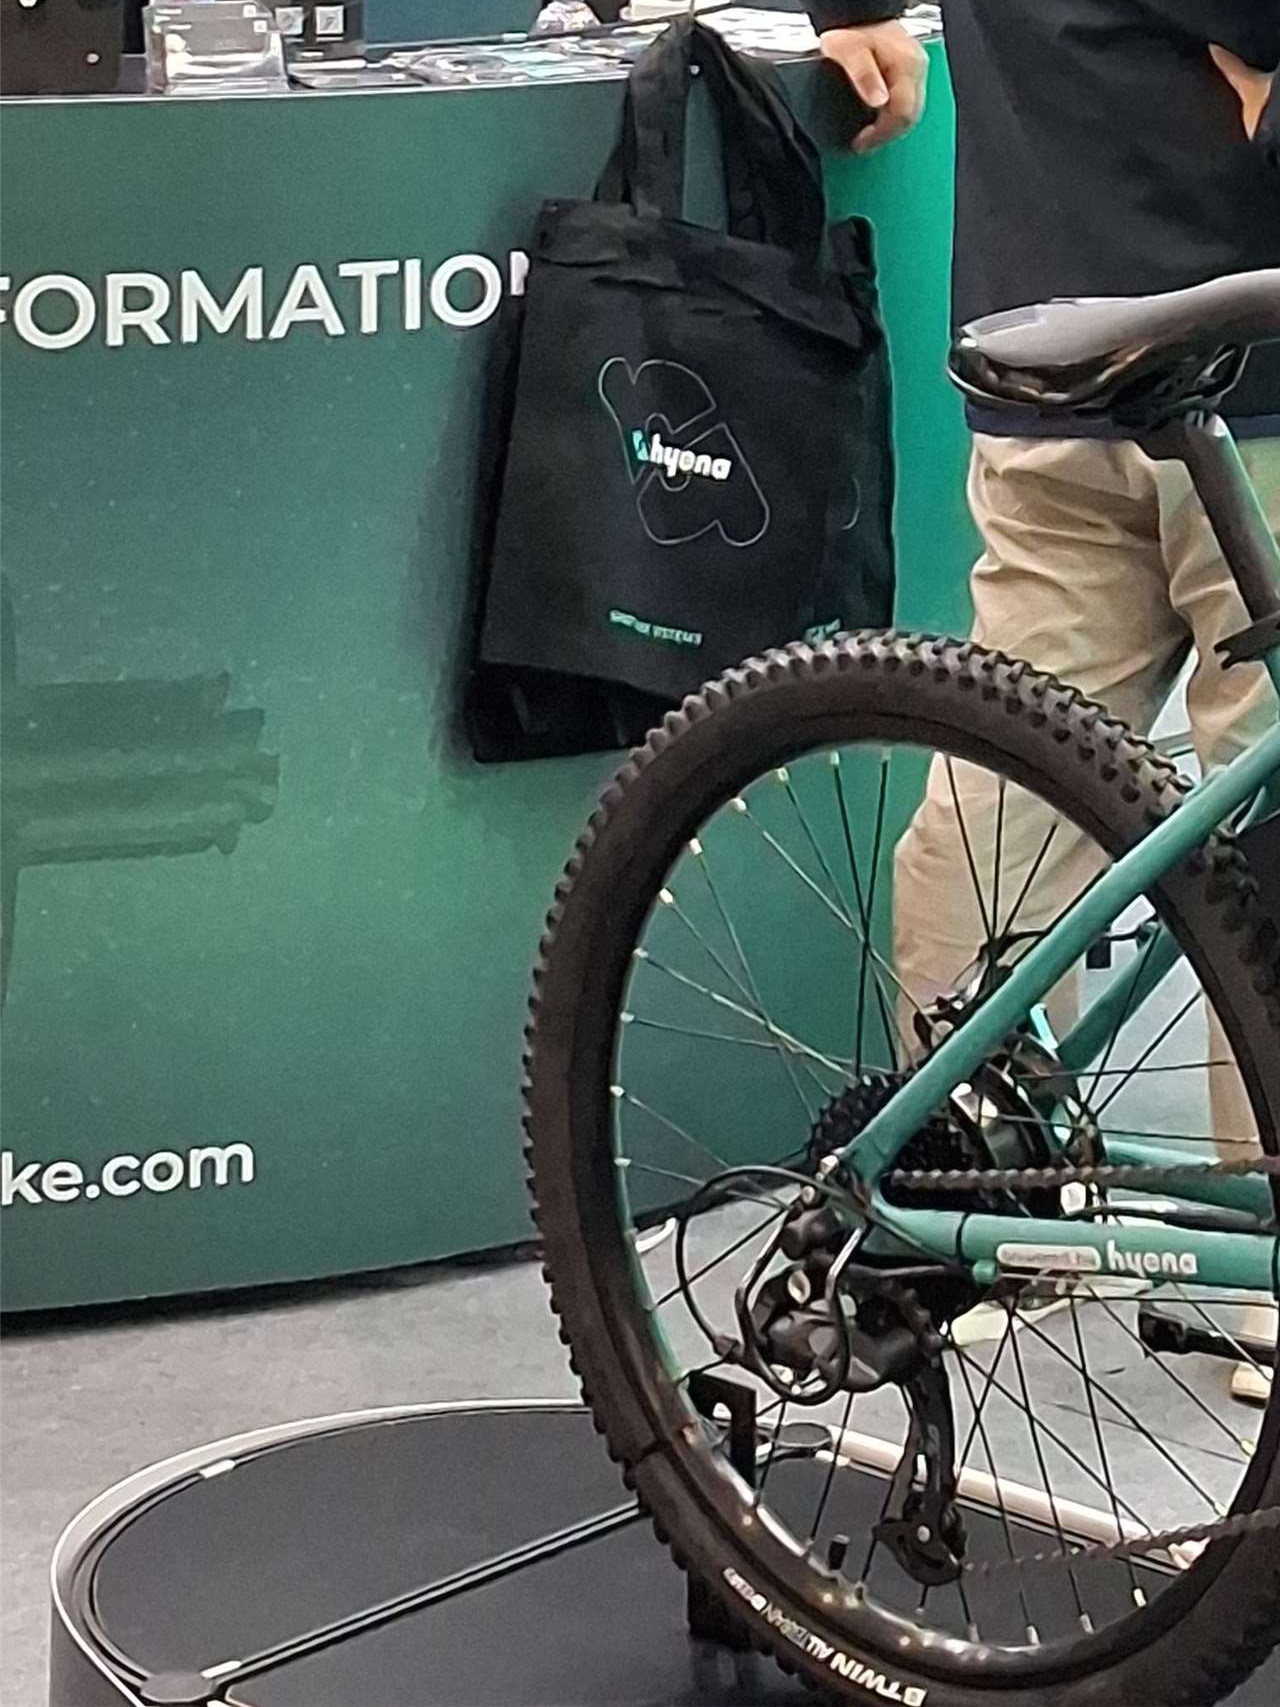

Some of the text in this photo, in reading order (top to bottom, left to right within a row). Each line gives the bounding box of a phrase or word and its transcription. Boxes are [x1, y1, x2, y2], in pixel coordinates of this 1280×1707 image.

[0, 251, 531, 350] ORMATIO
[0, 1142, 254, 1206] ke.com
[1108, 1240, 1198, 1278] hyena
